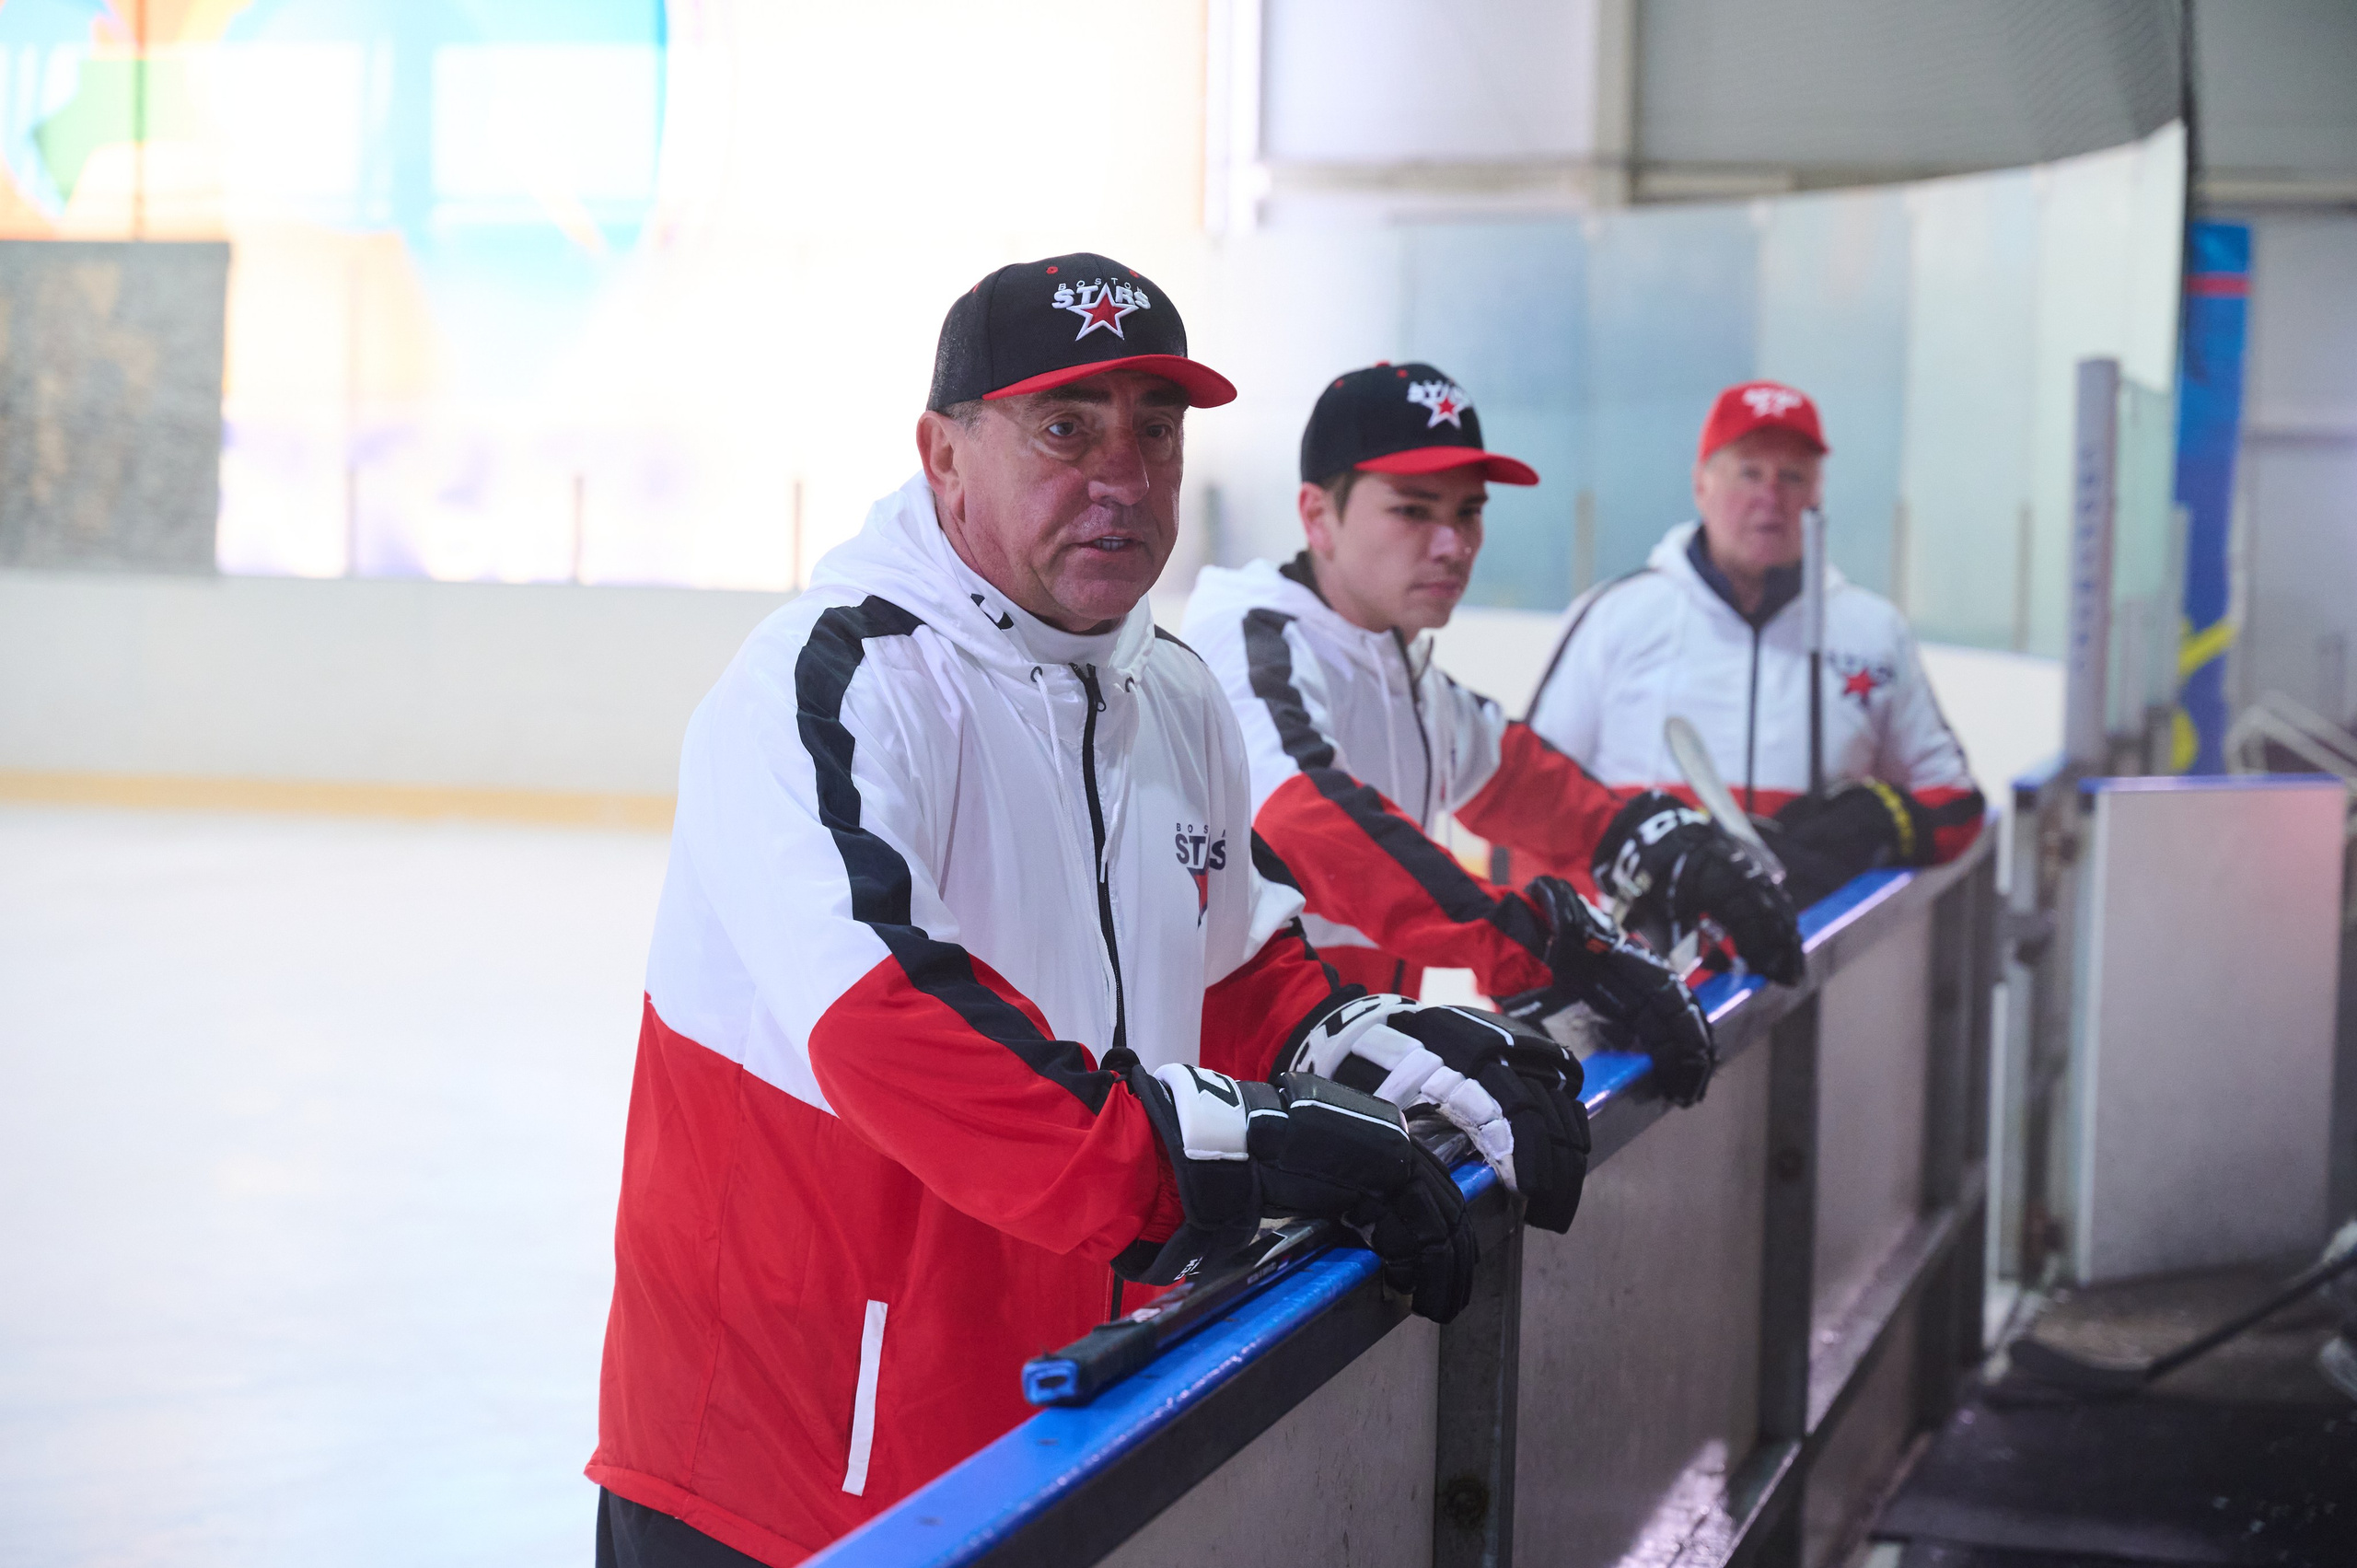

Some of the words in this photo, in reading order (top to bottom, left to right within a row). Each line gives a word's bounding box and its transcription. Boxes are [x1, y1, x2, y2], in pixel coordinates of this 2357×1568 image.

[1051, 282, 1151, 309] STARS
[1175, 832, 1225, 870] STS
[1173, 1259, 1198, 1281] CCM
